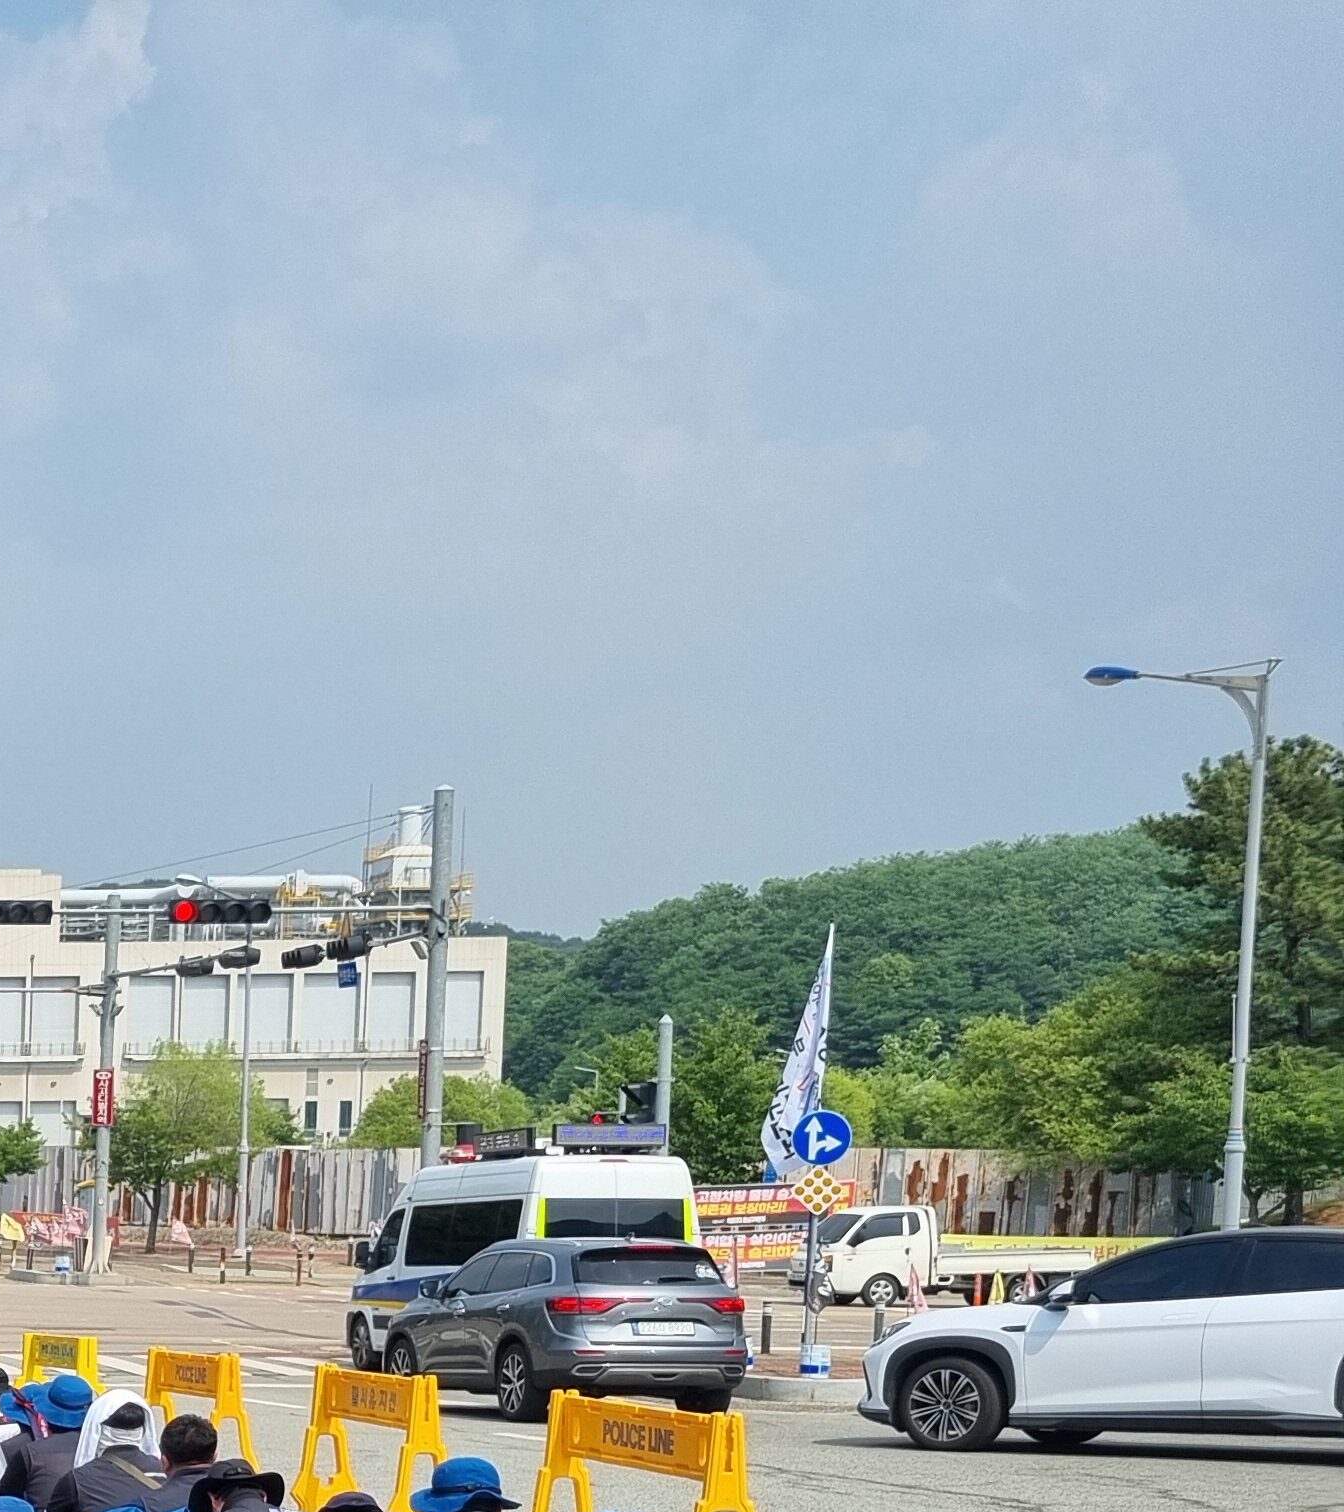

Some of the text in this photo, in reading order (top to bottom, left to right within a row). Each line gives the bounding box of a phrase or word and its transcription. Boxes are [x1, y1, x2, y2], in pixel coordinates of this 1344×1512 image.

[175, 1362, 196, 1383] POLICE
[602, 1418, 675, 1457] POLICE LINE
